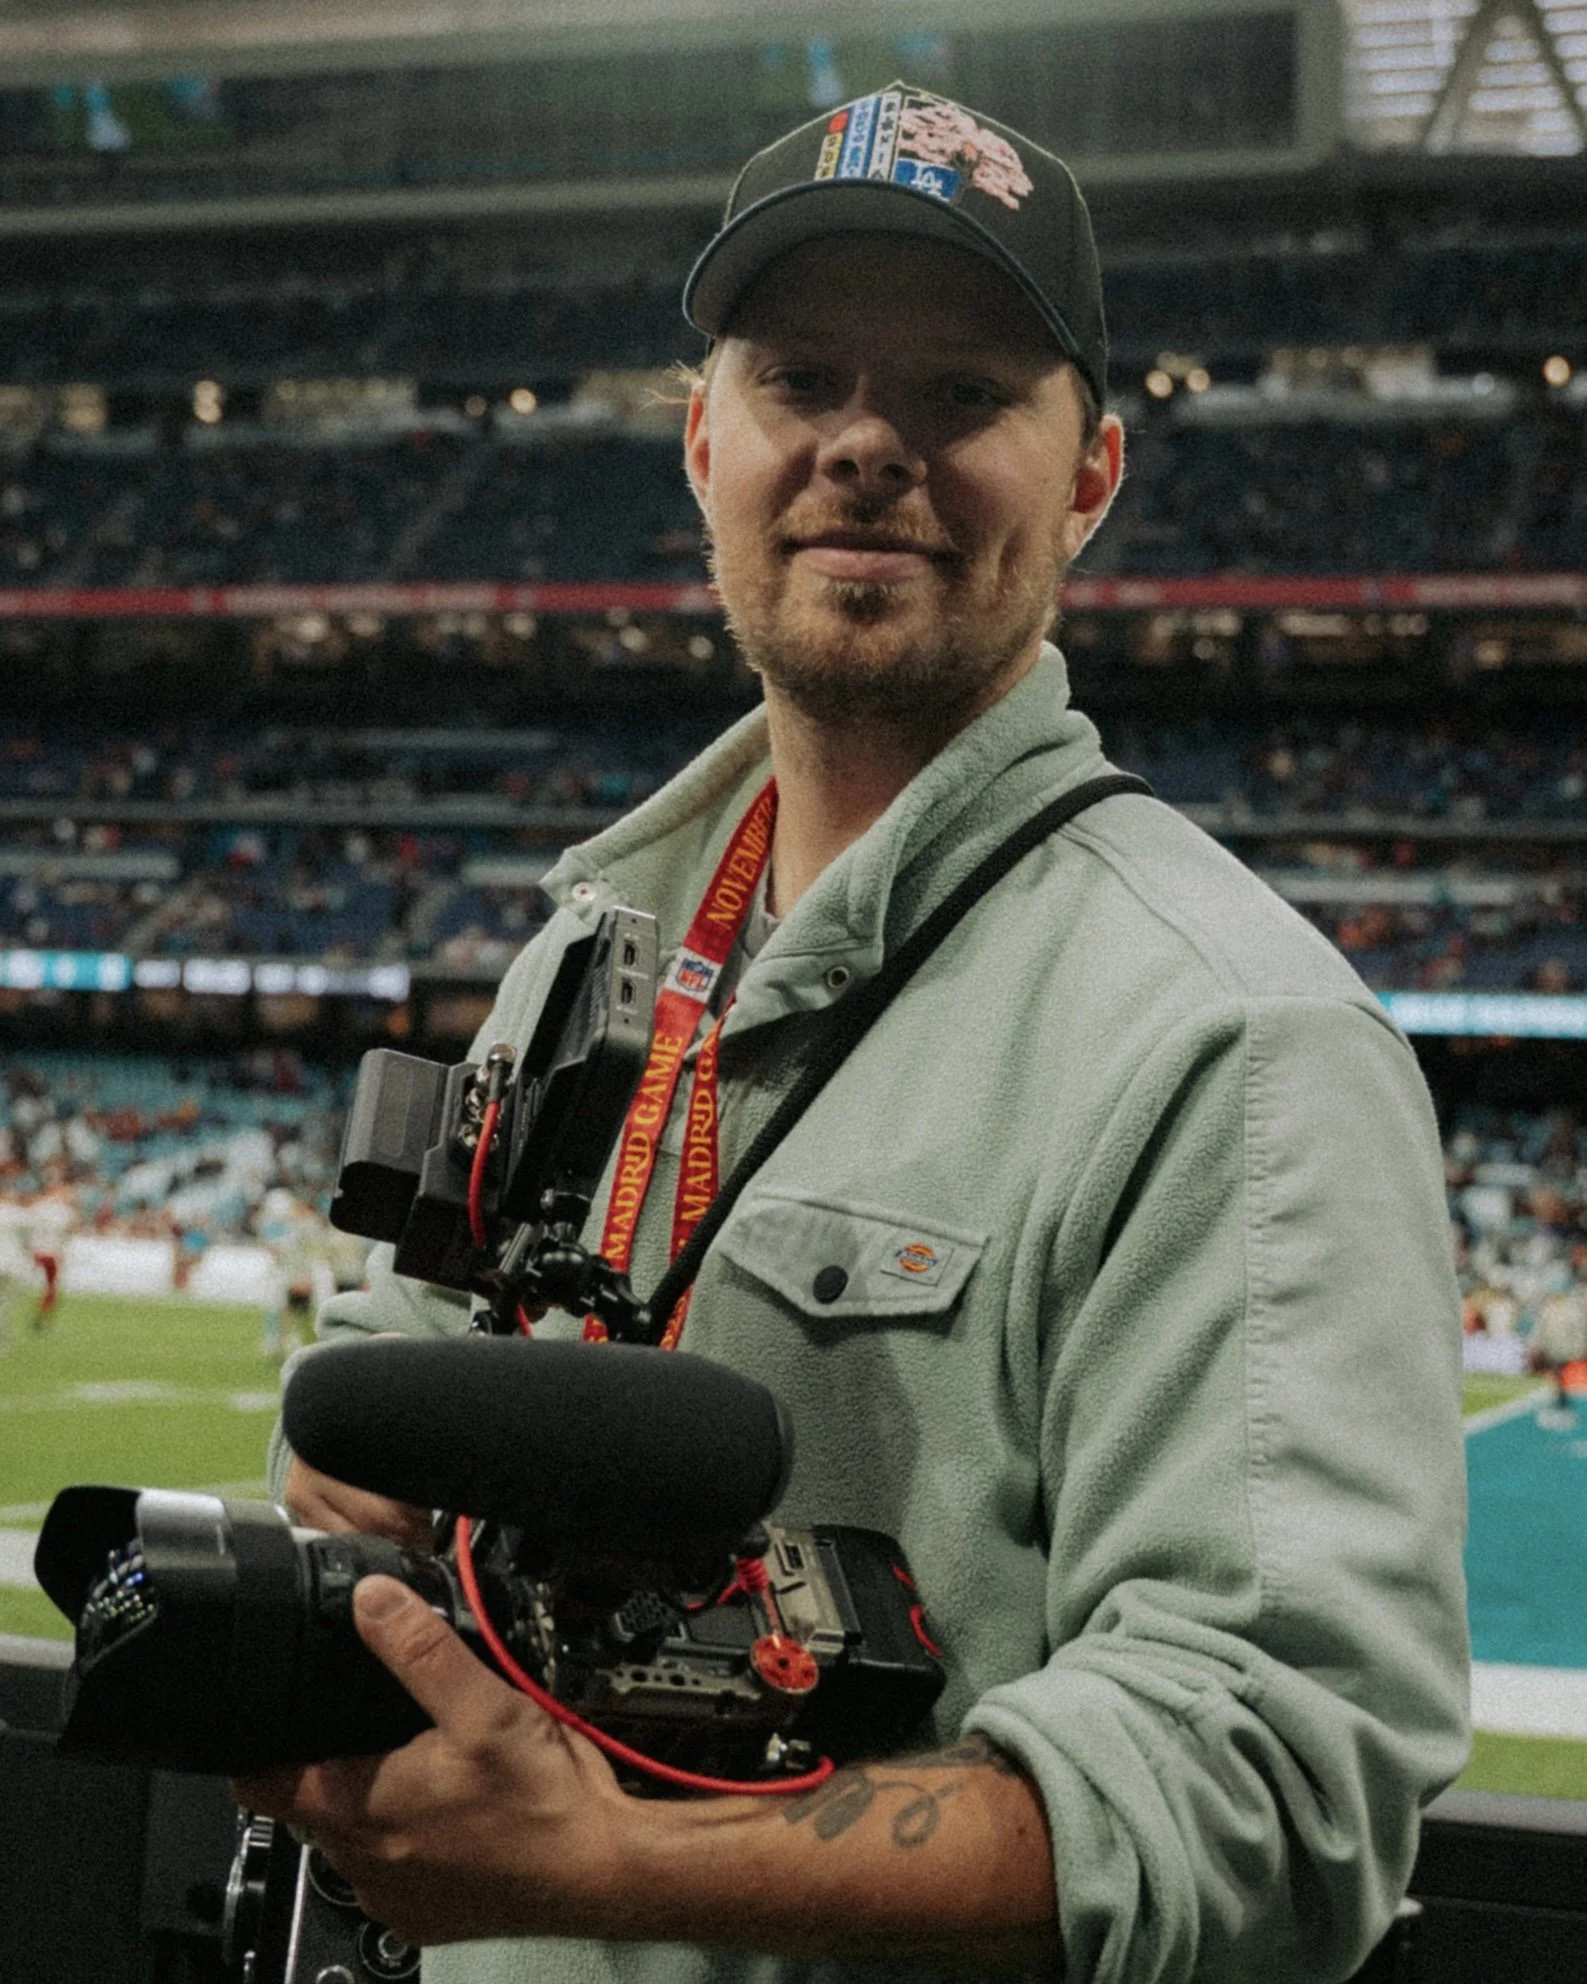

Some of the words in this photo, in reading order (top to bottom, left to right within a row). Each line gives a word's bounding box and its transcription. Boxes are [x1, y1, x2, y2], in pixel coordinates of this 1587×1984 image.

[606, 1132, 649, 1260] MADRID
[634, 1034, 684, 1126] GAME
[681, 1089, 714, 1221] MADRID
